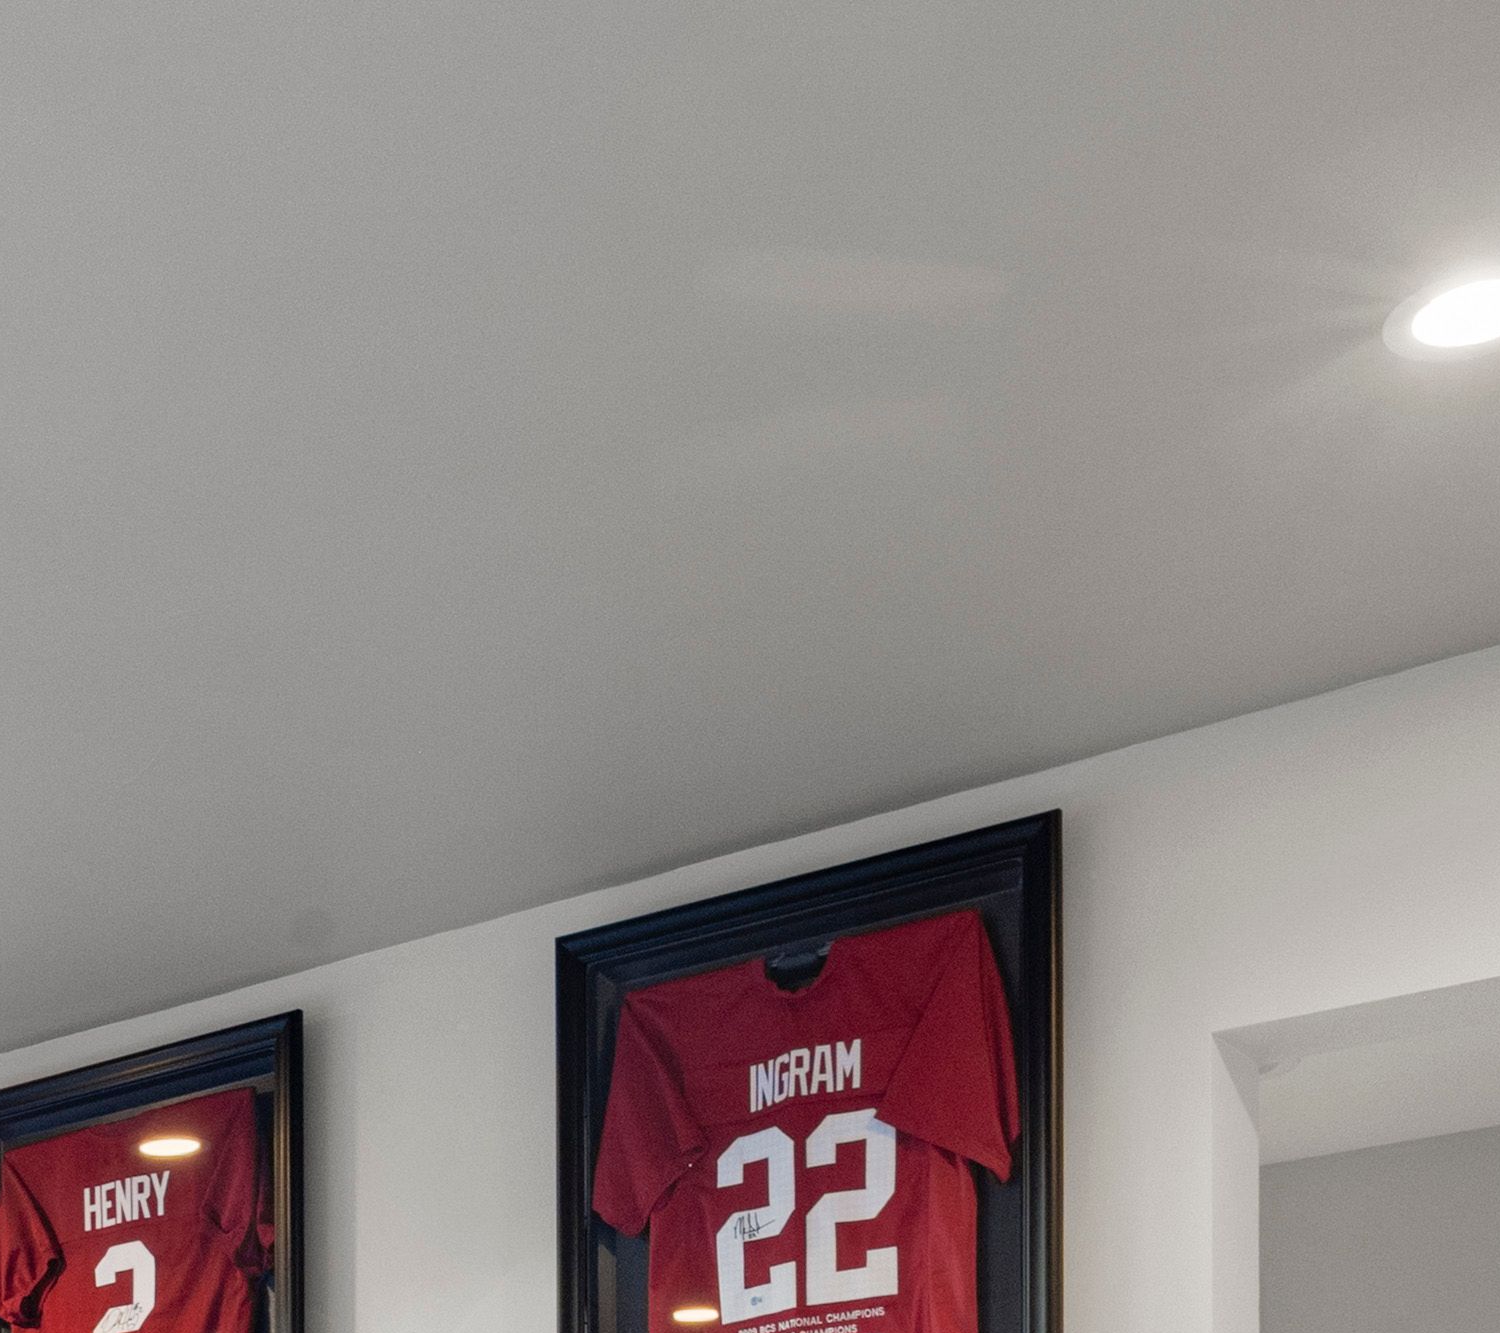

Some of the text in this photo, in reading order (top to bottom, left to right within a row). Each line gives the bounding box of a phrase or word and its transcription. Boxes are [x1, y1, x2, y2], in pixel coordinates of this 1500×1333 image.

[750, 1039, 861, 1113] INGRAM
[83, 1171, 170, 1232] HENRY
[716, 1108, 900, 1325] 22
[778, 1316, 822, 1331] NATIONAL
[826, 1307, 885, 1322] CHAMPIONS
